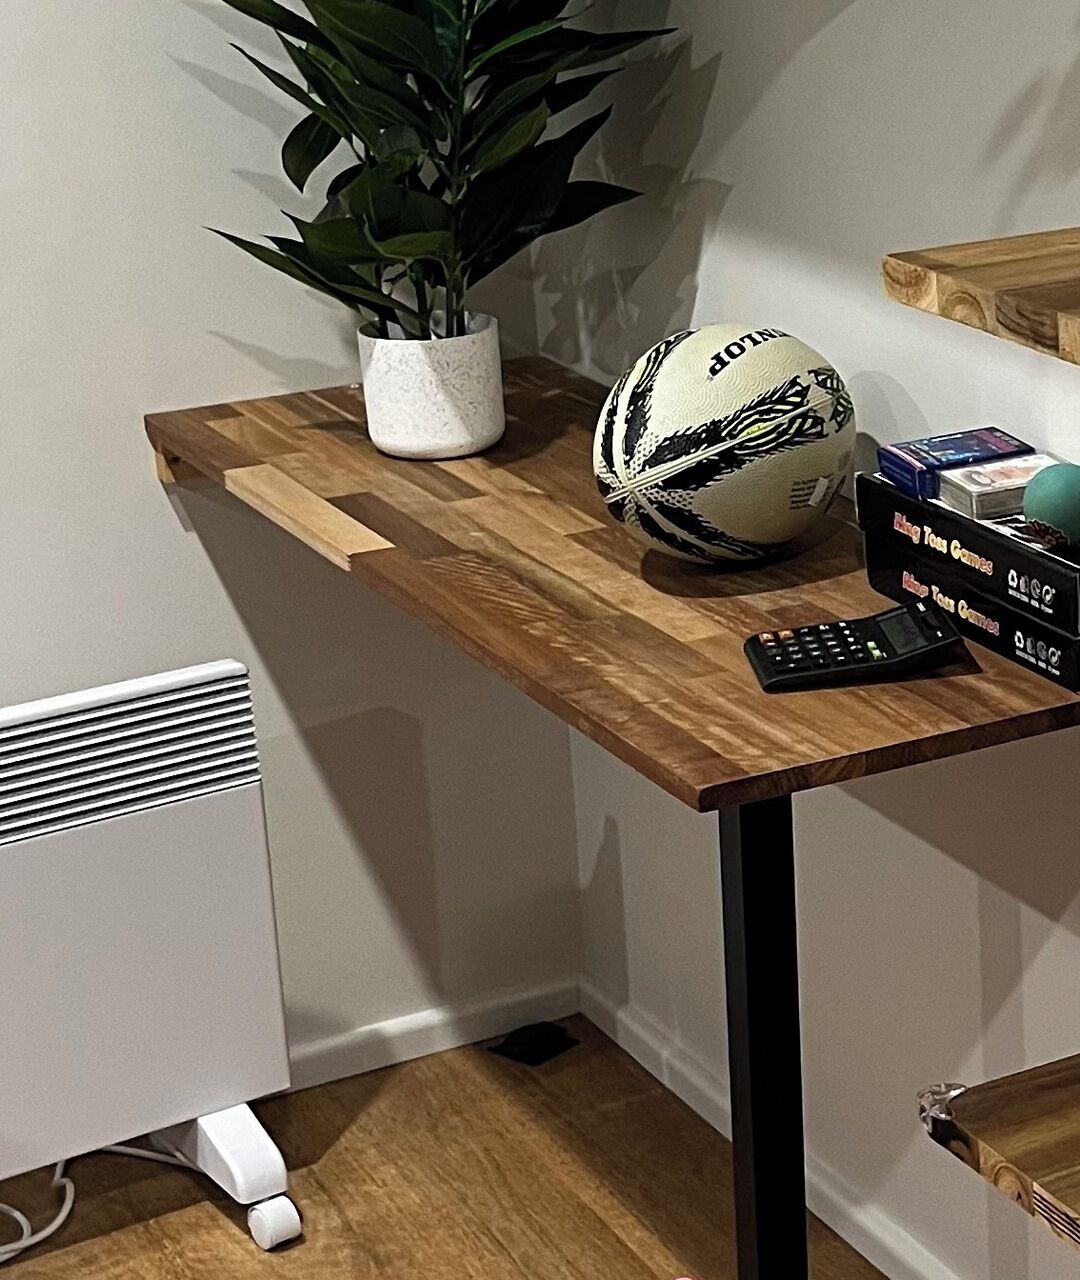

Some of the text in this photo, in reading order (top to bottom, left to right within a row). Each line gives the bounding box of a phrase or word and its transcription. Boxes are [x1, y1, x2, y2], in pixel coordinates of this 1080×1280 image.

[894, 511, 994, 576] Ring Toss Games
[902, 570, 929, 598] Ring
[931, 585, 955, 613] Toss
[957, 599, 1000, 636] Games
